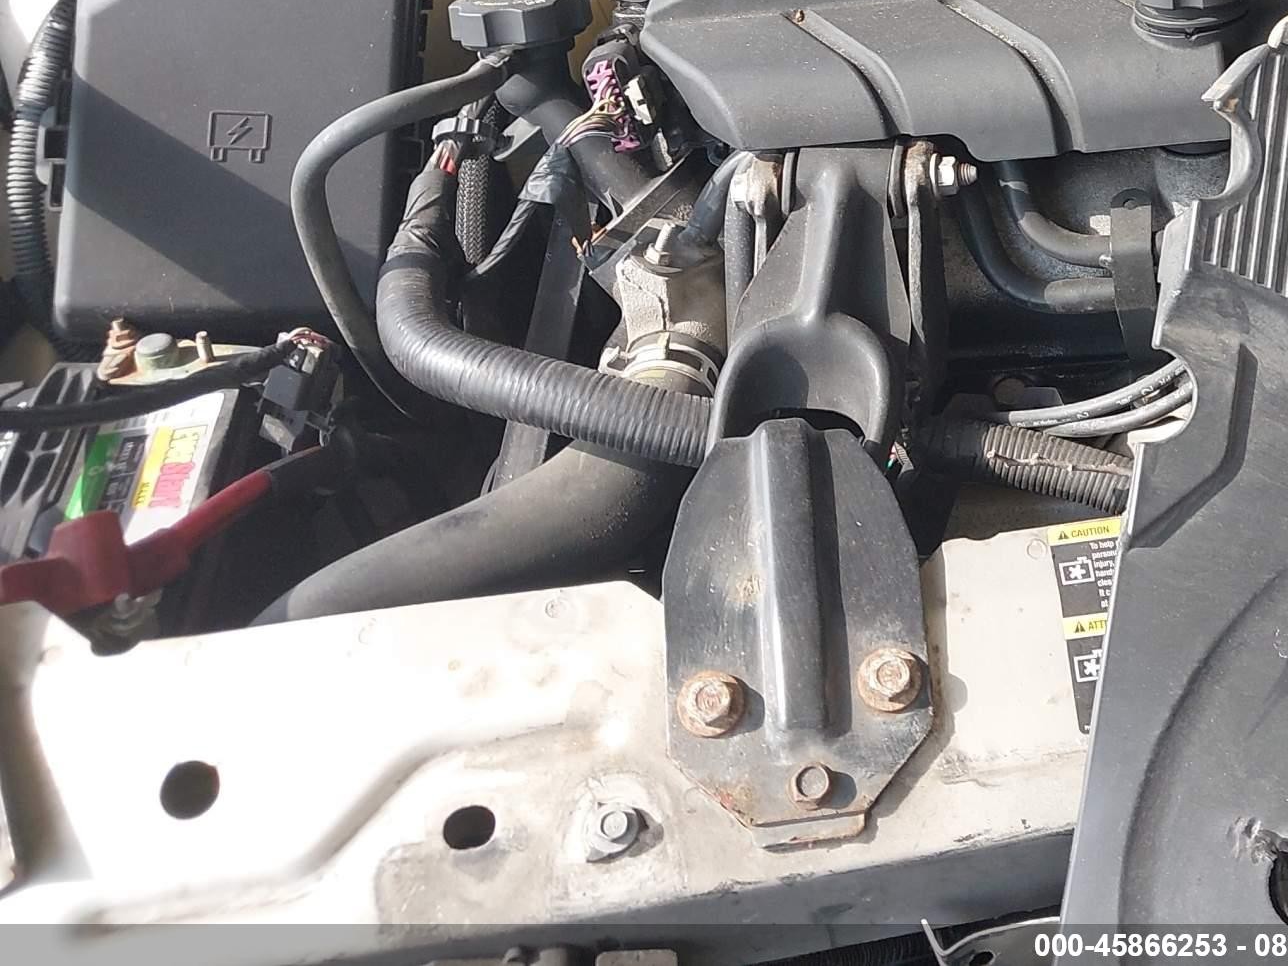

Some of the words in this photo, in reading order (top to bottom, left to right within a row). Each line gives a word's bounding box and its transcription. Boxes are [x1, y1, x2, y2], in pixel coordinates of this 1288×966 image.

[1071, 525, 1110, 538] CAUTION
[1089, 542, 1098, 550] To
[1098, 540, 1115, 550] help
[1095, 570, 1114, 579] hand
